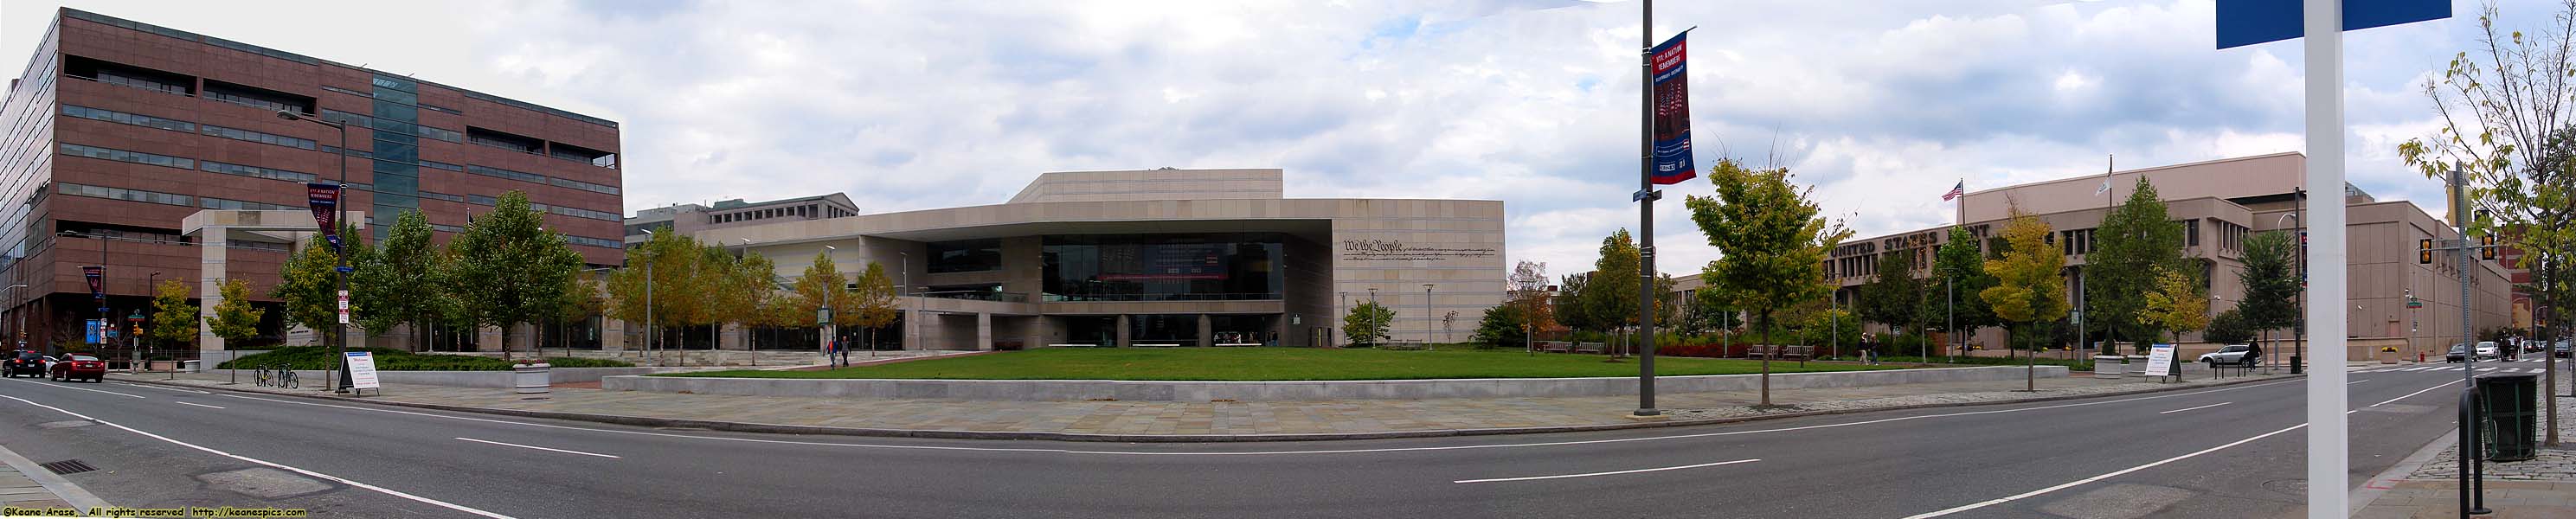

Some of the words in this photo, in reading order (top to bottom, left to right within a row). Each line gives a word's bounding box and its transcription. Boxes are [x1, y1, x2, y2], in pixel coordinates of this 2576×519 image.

[1344, 239, 1359, 251] We
[1372, 239, 1403, 253] People
[1830, 240, 1876, 258] UNITED
[1884, 231, 1938, 250] STATES
